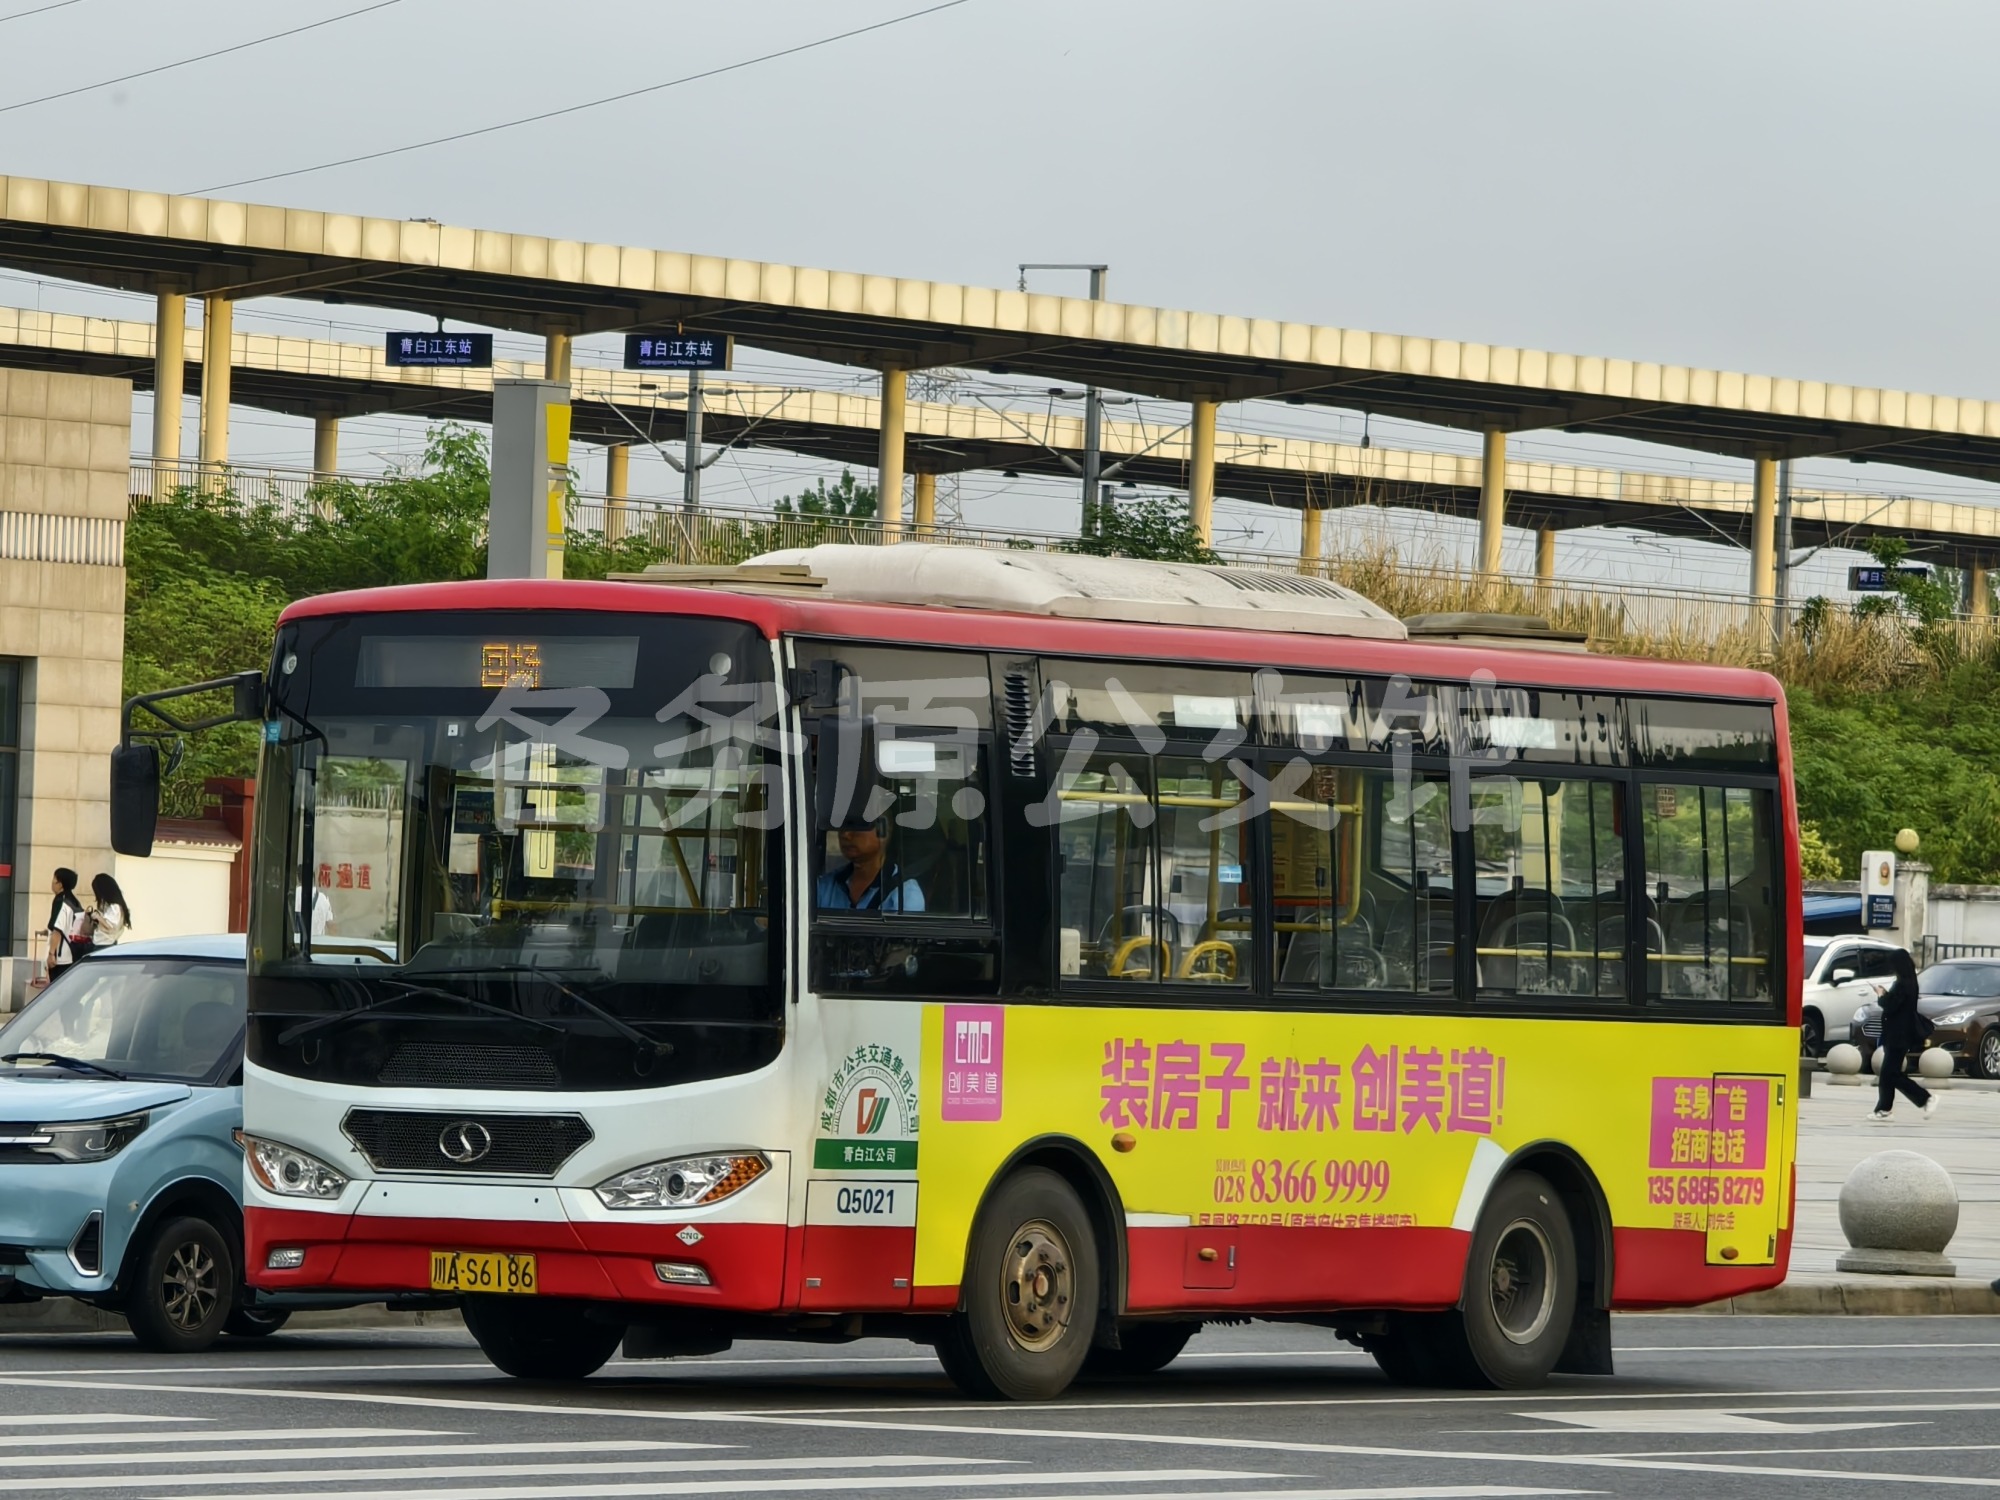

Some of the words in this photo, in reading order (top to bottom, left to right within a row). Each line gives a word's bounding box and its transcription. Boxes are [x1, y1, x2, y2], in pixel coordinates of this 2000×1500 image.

[401, 338, 472, 354] 青白江东站
[640, 340, 713, 357] 青白江东站
[820, 1043, 919, 1133] 成都市公共交通集团公司
[1673, 1084, 1747, 1121] 车身广告
[843, 1146, 896, 1163] 青白江公司
[1671, 1127, 1746, 1163] 招商电话
[1214, 1175, 1245, 1203] 028
[1250, 1158, 1318, 1203] 8366
[1323, 1159, 1390, 1203] 9999
[1647, 1176, 1674, 1205] 135
[1677, 1176, 1720, 1205] 6885
[1722, 1176, 1764, 1206] 8279
[837, 1187, 894, 1214] Q5021
[680, 1232, 699, 1240] CNG
